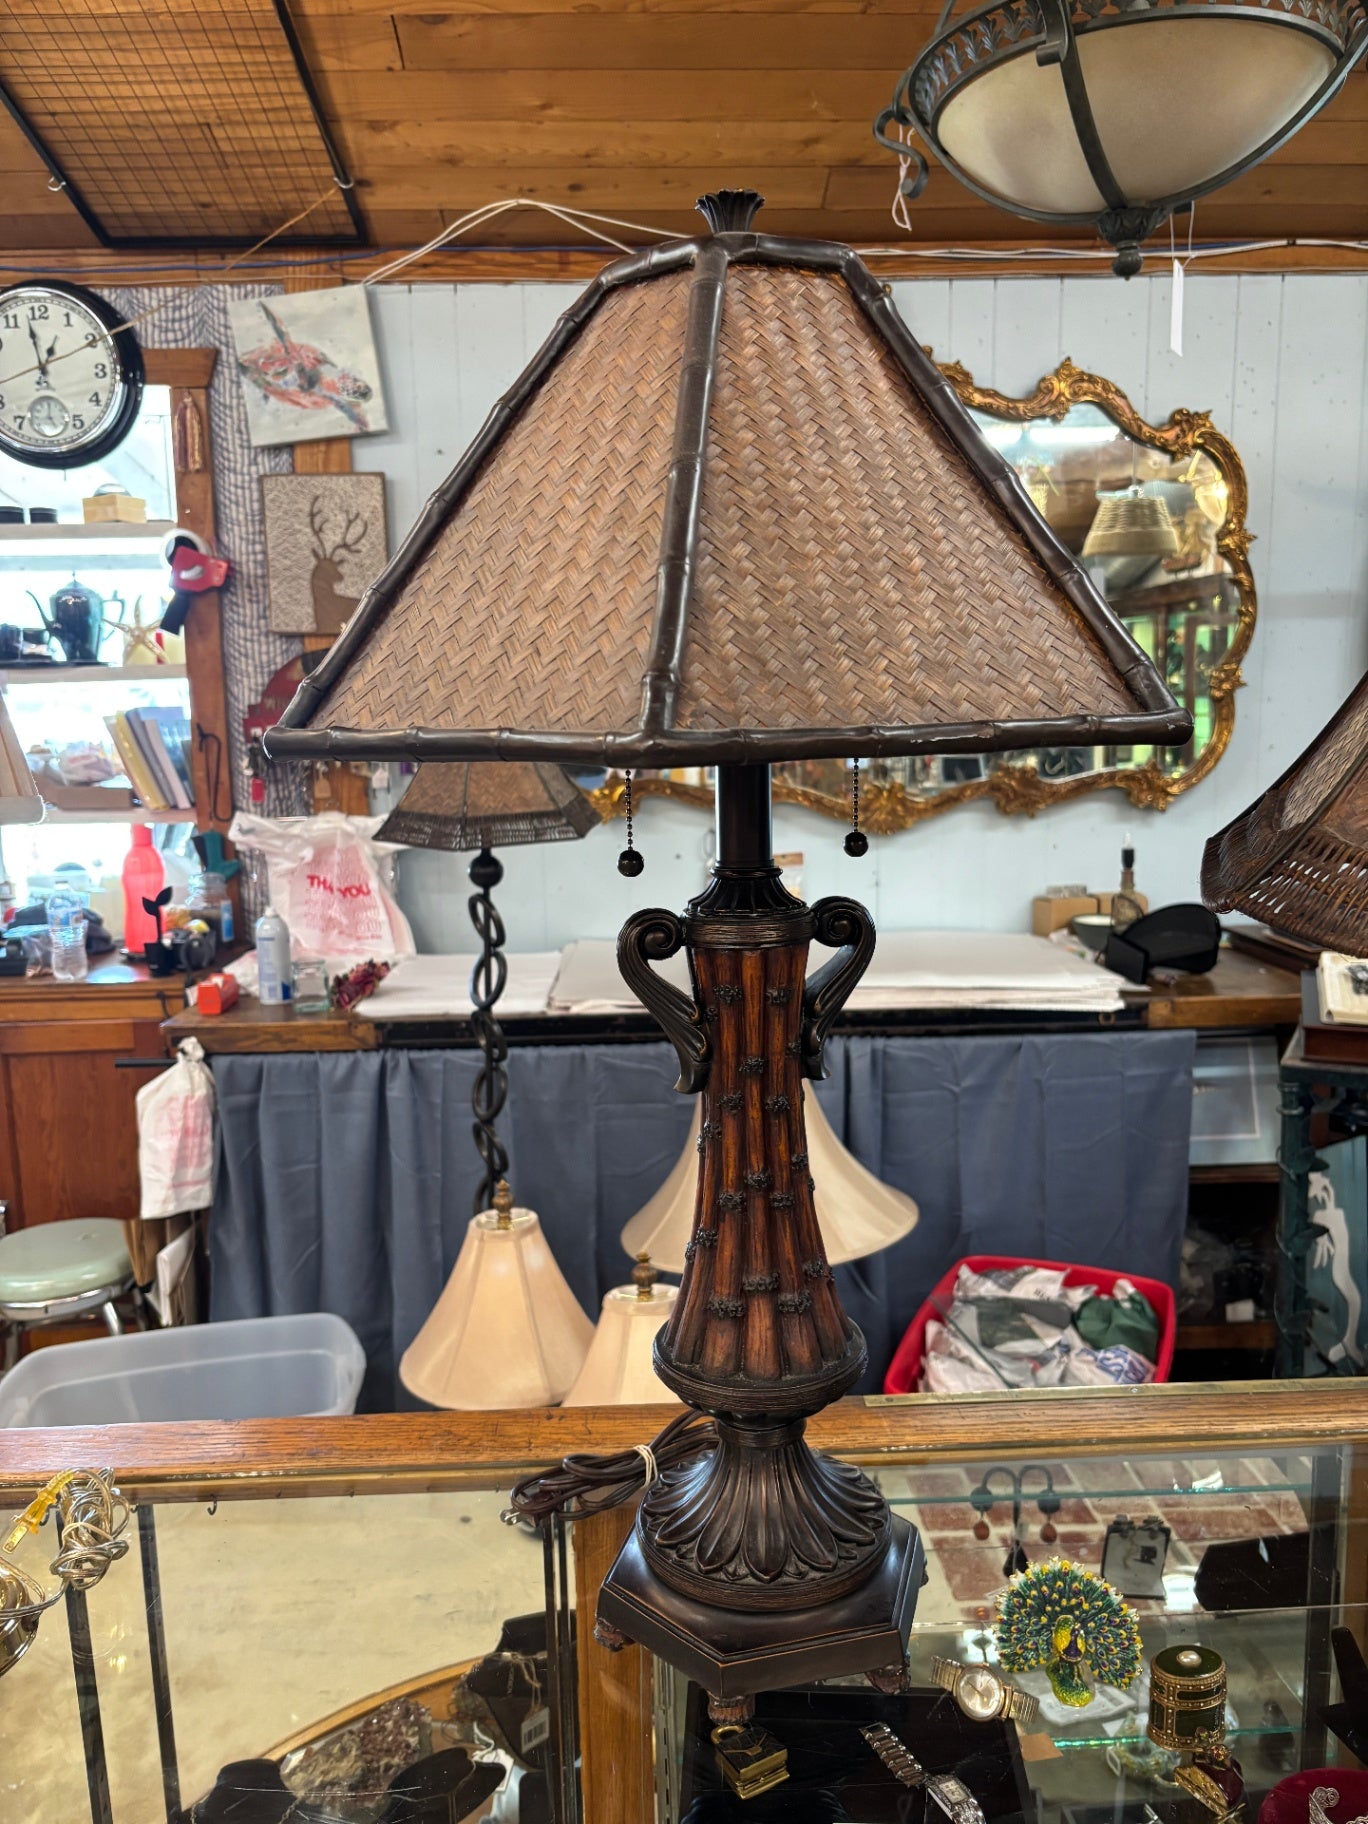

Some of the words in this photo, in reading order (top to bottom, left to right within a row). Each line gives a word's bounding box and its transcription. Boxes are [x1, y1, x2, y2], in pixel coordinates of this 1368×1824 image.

[29, 305, 49, 320] 12
[63, 312, 73, 326] 1
[3, 314, 20, 328] 11
[85, 333, 97, 347] 2
[94, 363, 107, 378] 3
[89, 392, 101, 406] 4
[14, 416, 25, 430] 7
[72, 415, 84, 429] 5
[337, 883, 370, 898] YOU
